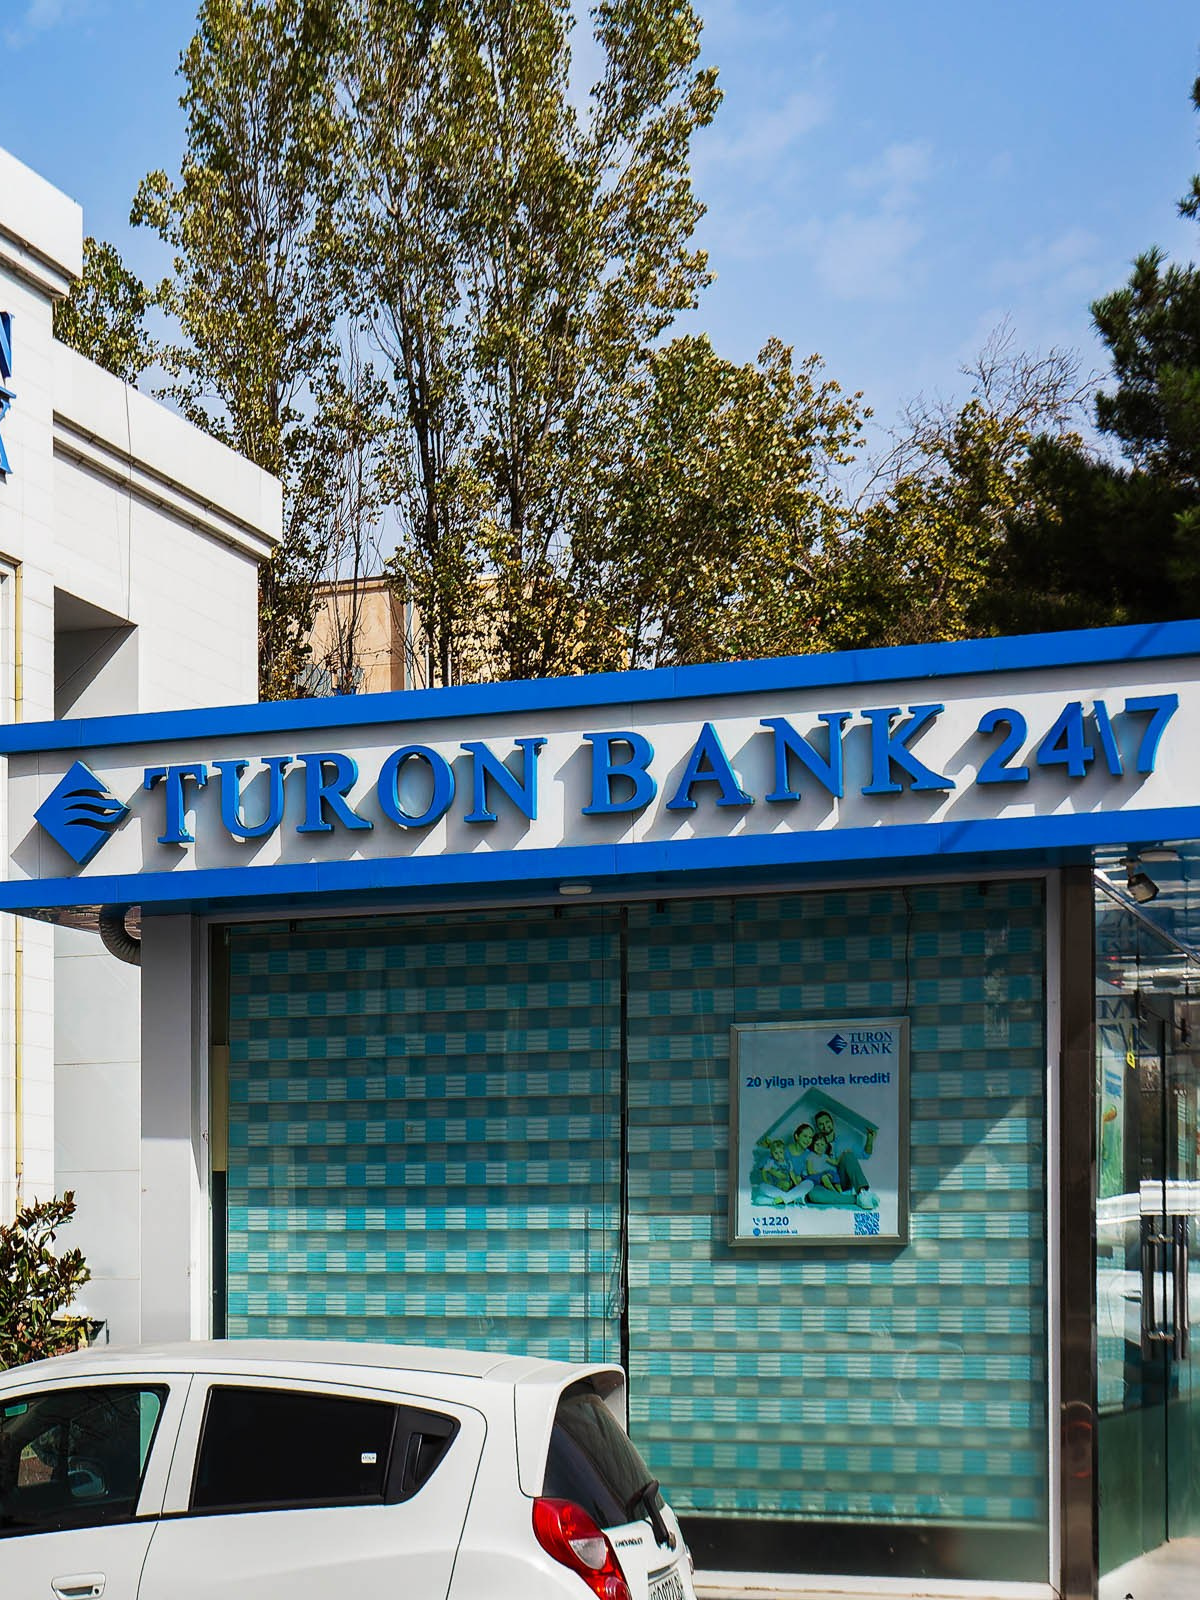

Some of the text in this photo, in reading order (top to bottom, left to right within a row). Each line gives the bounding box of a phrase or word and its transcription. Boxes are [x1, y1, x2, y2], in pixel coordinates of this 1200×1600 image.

[143, 693, 1179, 845] TURON BANK 24\7
[849, 1032, 892, 1042] TURON
[851, 1043, 892, 1055] BANK
[746, 1072, 890, 1088] 20 yilga ipoteka krediti
[762, 1217, 789, 1226] 1220
